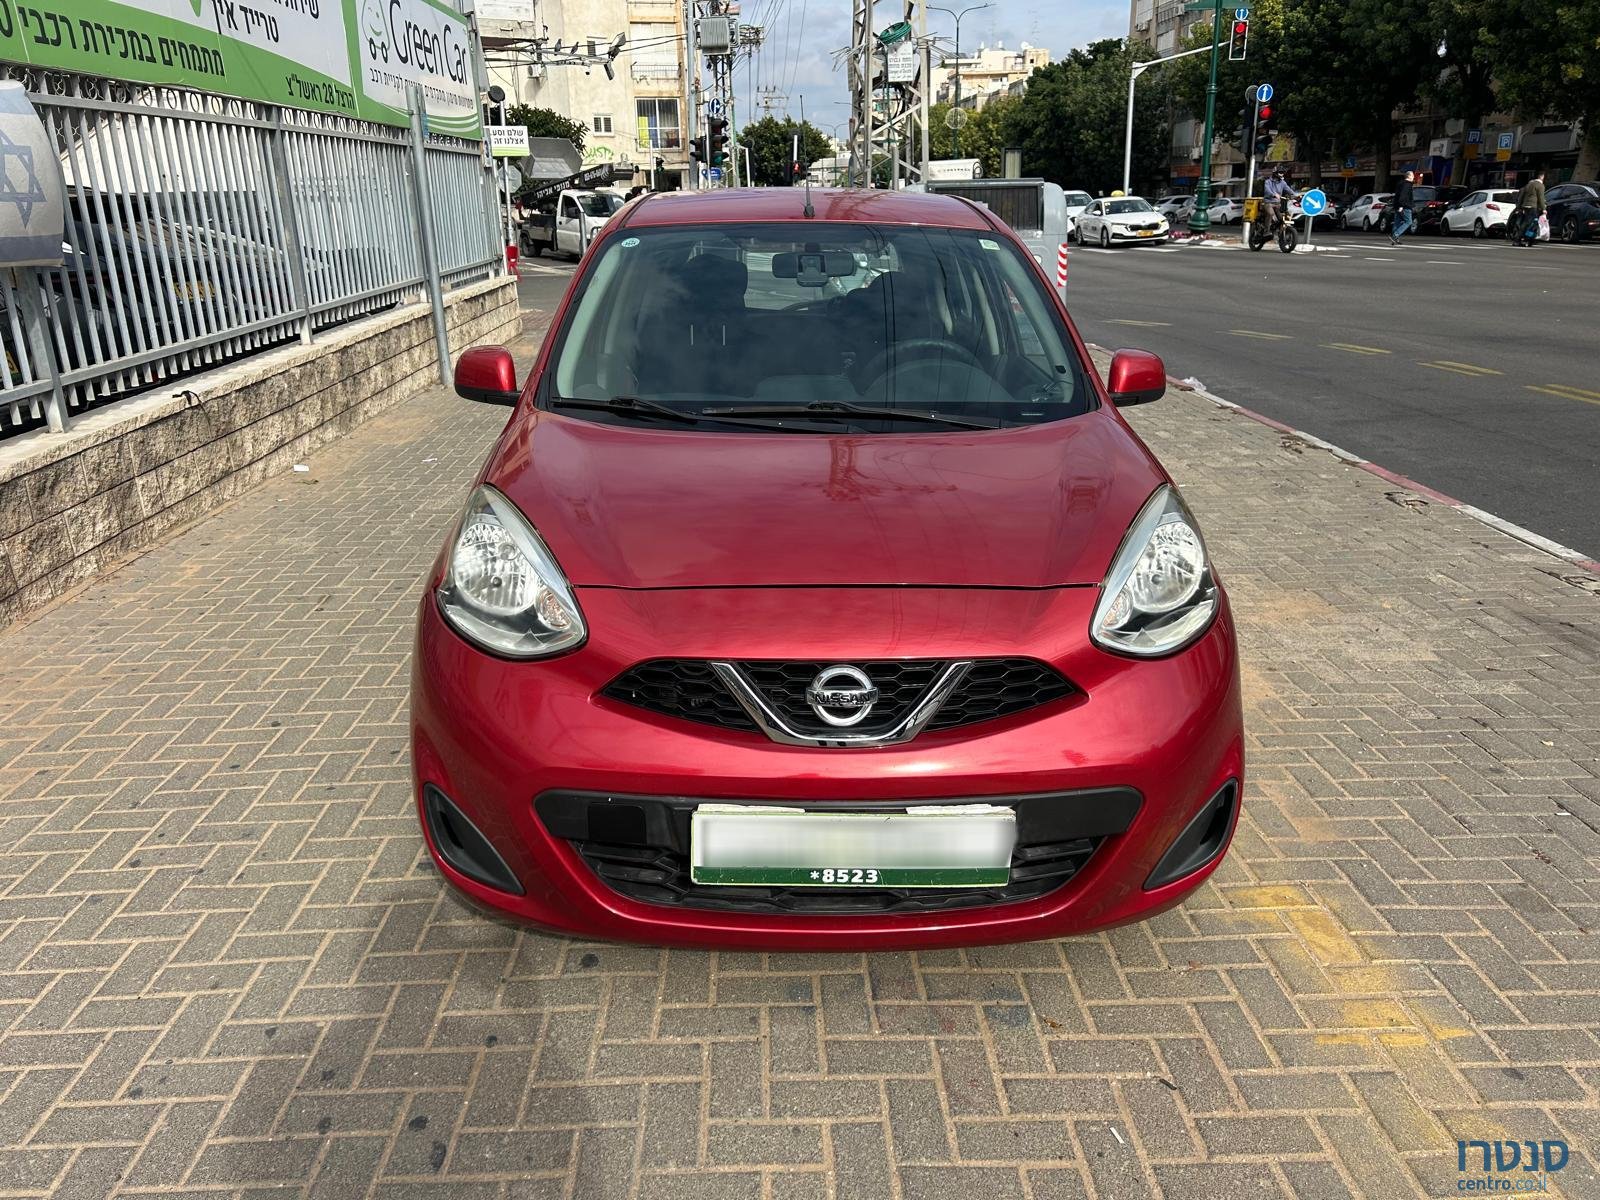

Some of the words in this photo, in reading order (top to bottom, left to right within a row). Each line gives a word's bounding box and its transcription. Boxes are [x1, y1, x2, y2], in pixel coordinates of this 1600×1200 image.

[17, 6, 77, 49] רכבי
[212, 0, 239, 35] אין
[239, 5, 279, 43] טרייד
[79, 19, 157, 63] במכירת
[158, 36, 225, 77] מתמחים
[390, 0, 444, 77] Green
[444, 24, 467, 85] Car
[322, 82, 335, 105] 28
[370, 68, 383, 84] רכב
[334, 84, 355, 110] הרצל
[814, 691, 871, 704] NISSAN
